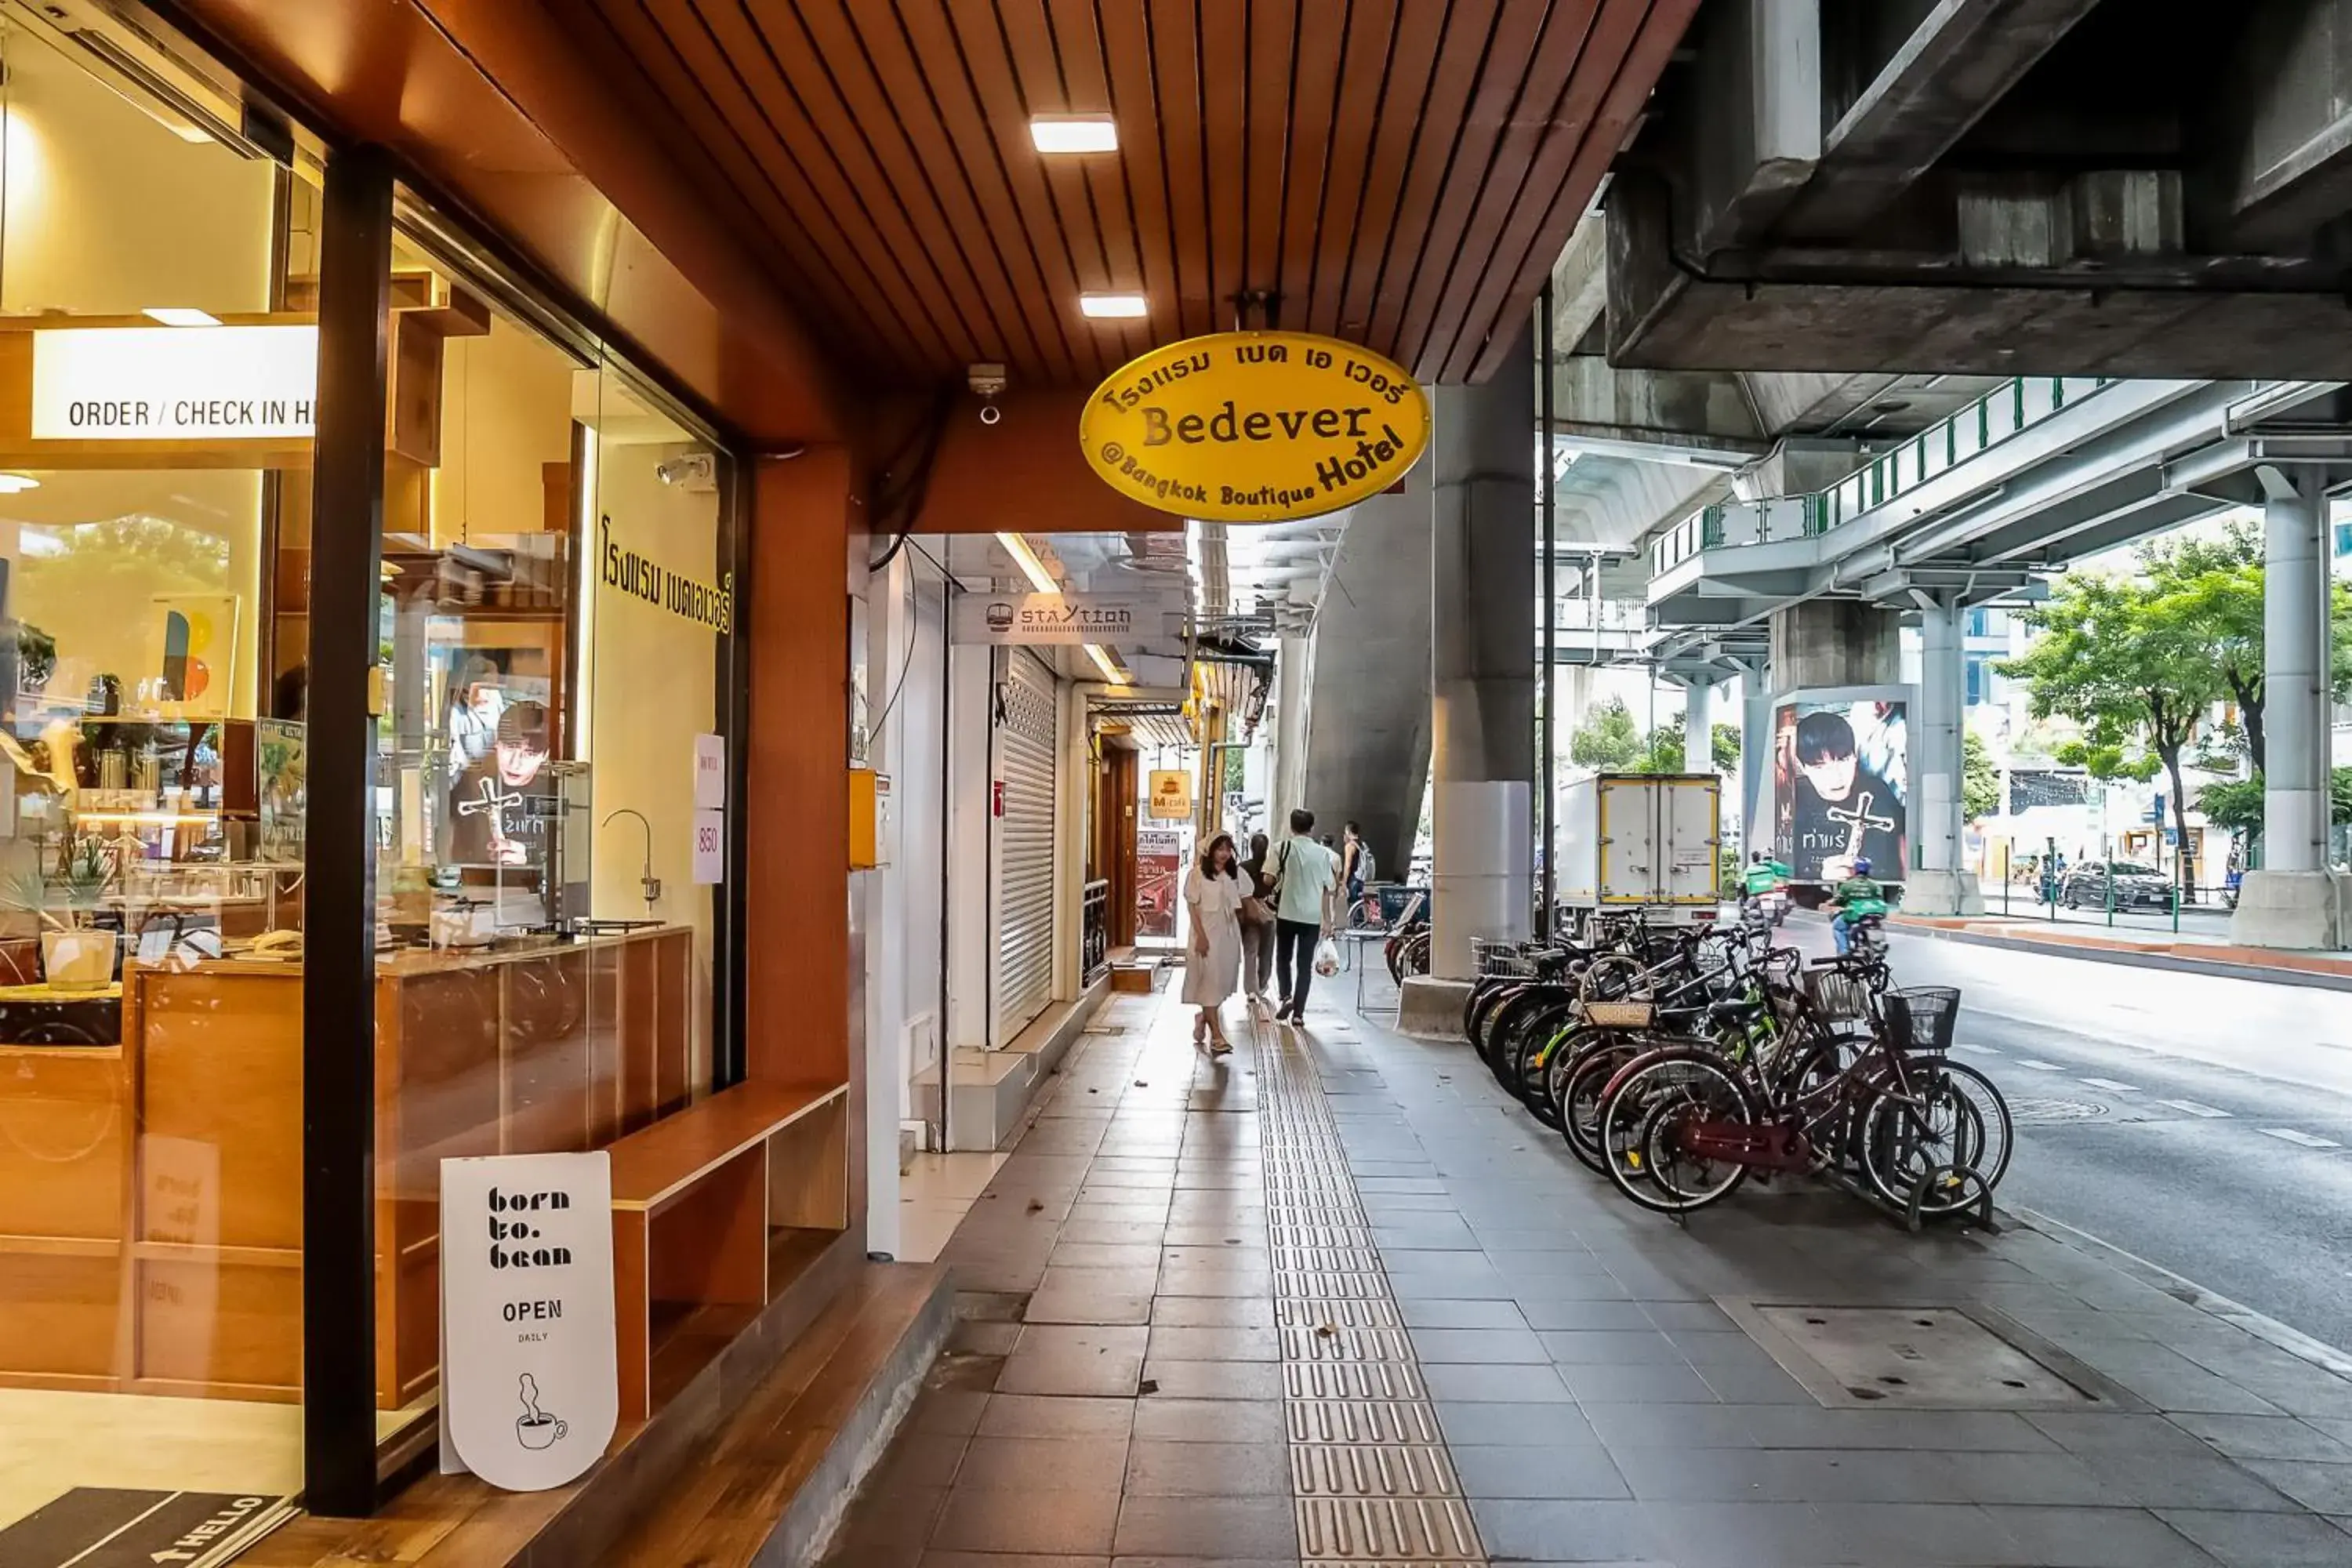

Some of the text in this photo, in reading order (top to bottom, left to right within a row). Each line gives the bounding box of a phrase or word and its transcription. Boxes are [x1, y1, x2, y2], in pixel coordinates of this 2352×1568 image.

[1102, 344, 1410, 414] โรงแรม เบด เอ เวอร์
[69, 401, 148, 426] ORDER
[175, 401, 254, 426] CHECK
[262, 401, 285, 424] IN
[295, 400, 316, 424] H
[1142, 401, 1371, 446] Bedever
[1220, 485, 1315, 509] Boutique
[1316, 423, 1404, 492] Hotel
[601, 514, 661, 605] โรงแรม
[488, 1186, 570, 1213] born
[490, 1243, 572, 1269] bean
[503, 1299, 562, 1322] OPEN
[518, 1332, 548, 1343] DAILY
[175, 1497, 263, 1547] HELLO
